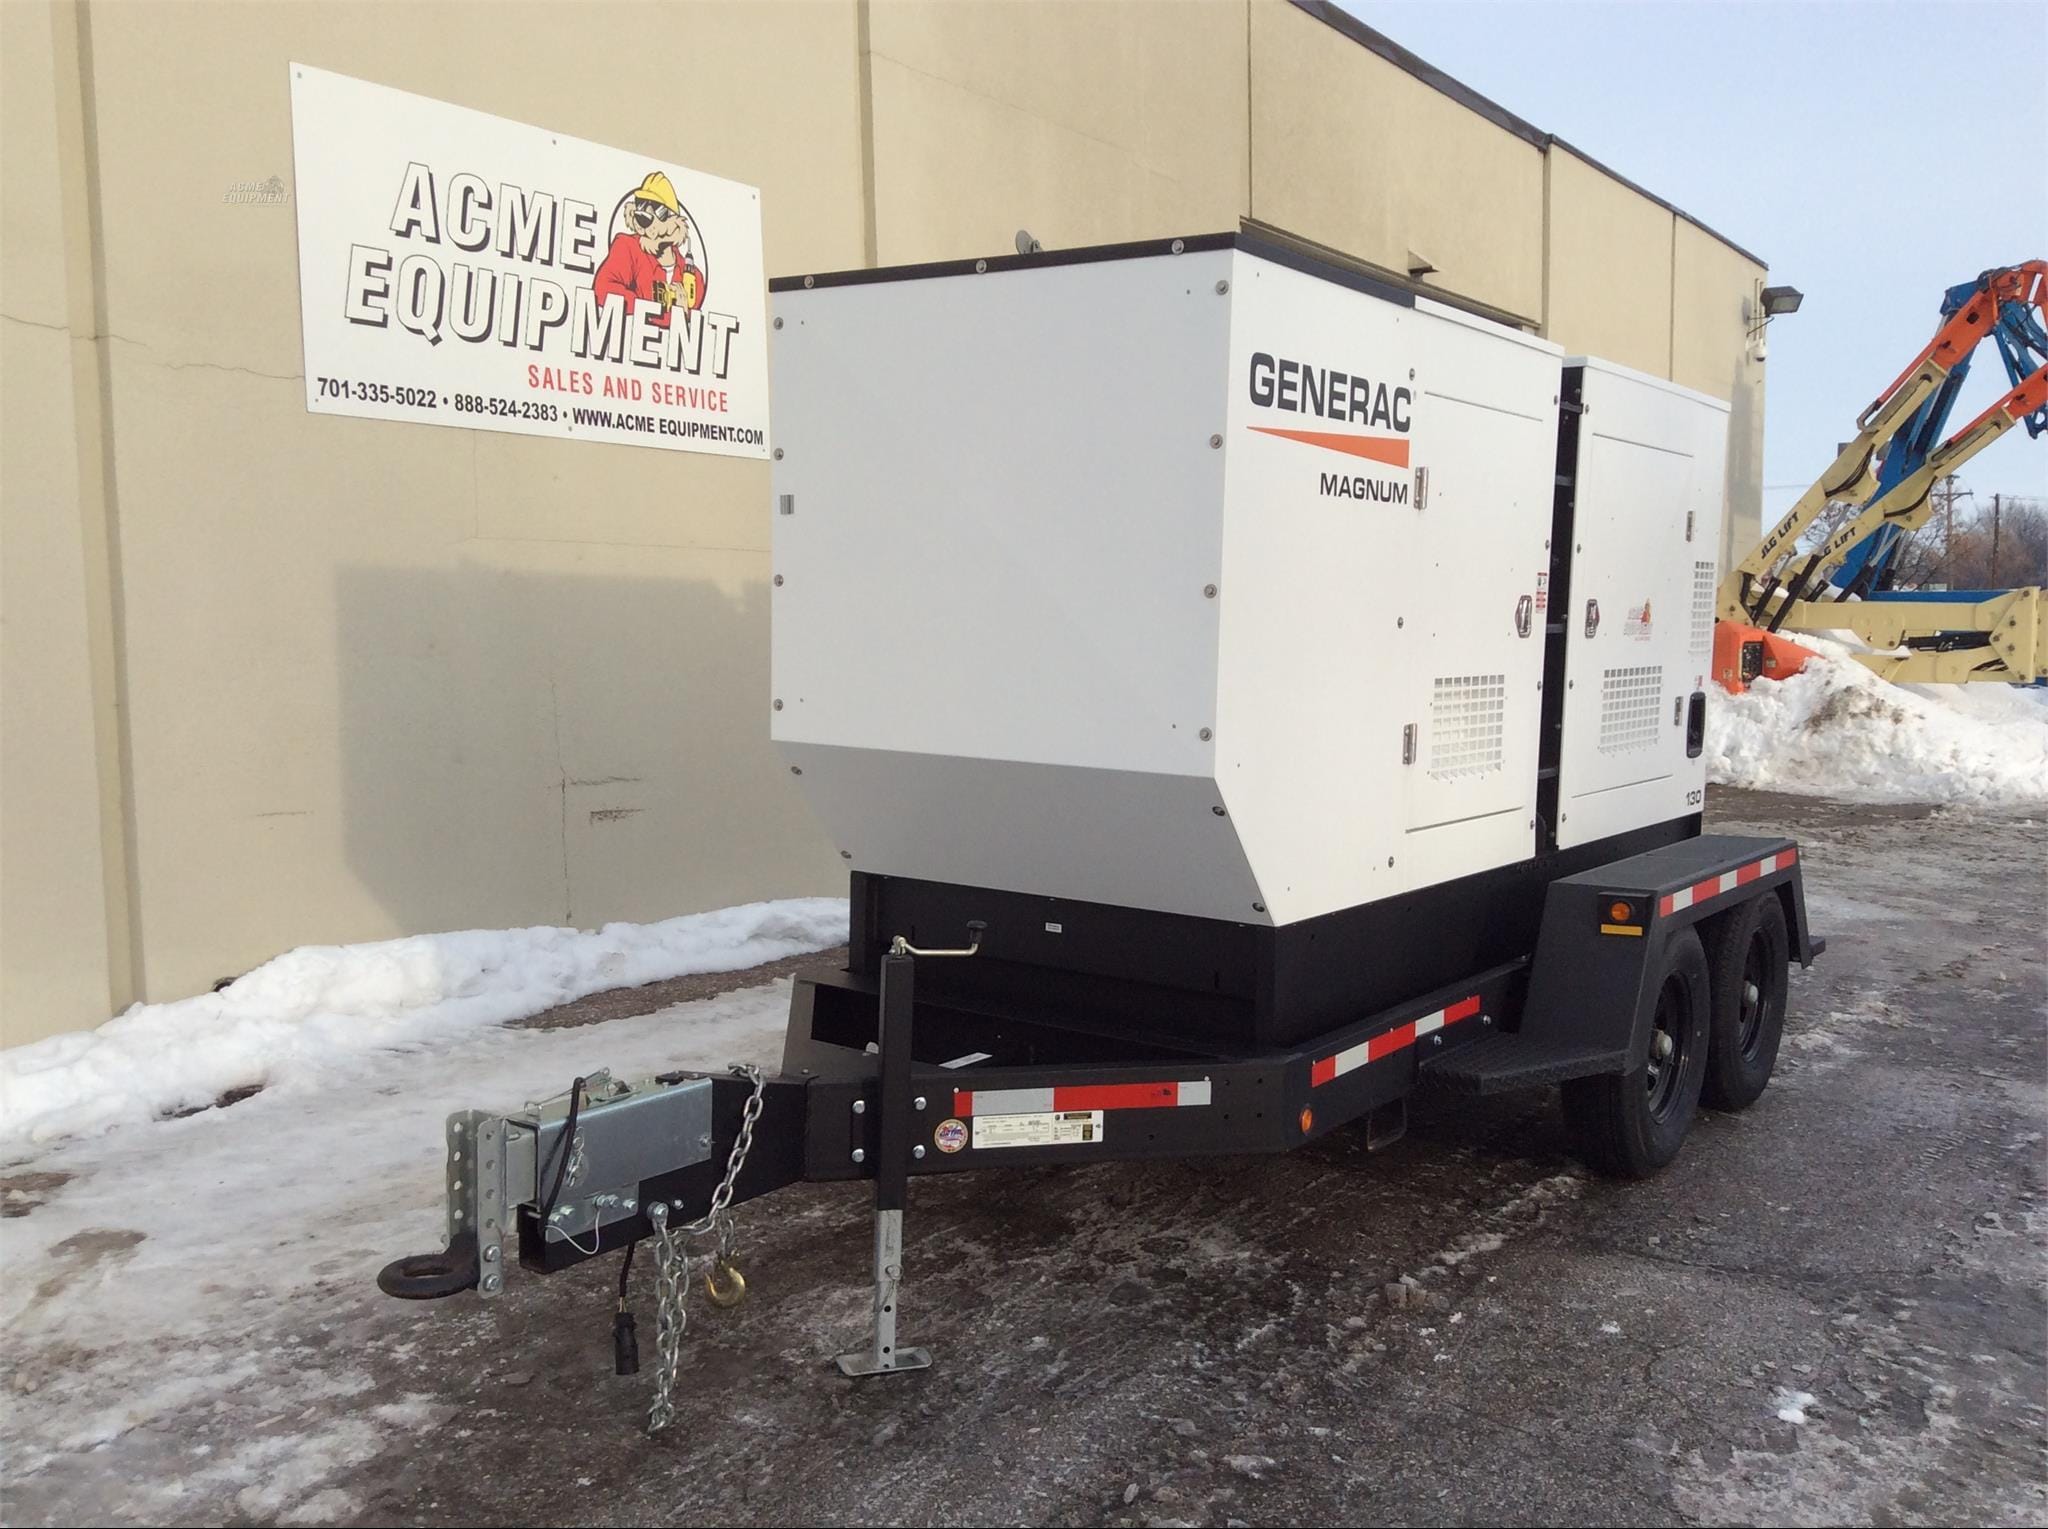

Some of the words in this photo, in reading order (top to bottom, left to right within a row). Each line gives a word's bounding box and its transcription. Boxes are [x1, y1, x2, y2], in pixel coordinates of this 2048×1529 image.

[389, 161, 598, 274] ACME
[344, 243, 740, 380] EQUIPMENT
[316, 376, 438, 409] 701-335-5022
[454, 393, 559, 422] 888-524-2383
[572, 407, 656, 433] WWW.ACME
[659, 418, 765, 446] EQUIPMENT.COM
[527, 363, 594, 396] SALES
[603, 375, 643, 401] AND
[651, 381, 729, 413] SERVICE
[1249, 351, 1412, 433] GENERAC
[1319, 472, 1409, 505] MAGNUM
[1760, 536, 1778, 560] JLG
[1777, 511, 1801, 539] LIFT
[1833, 526, 1857, 549] LIFT
[1686, 789, 1702, 806] 130
